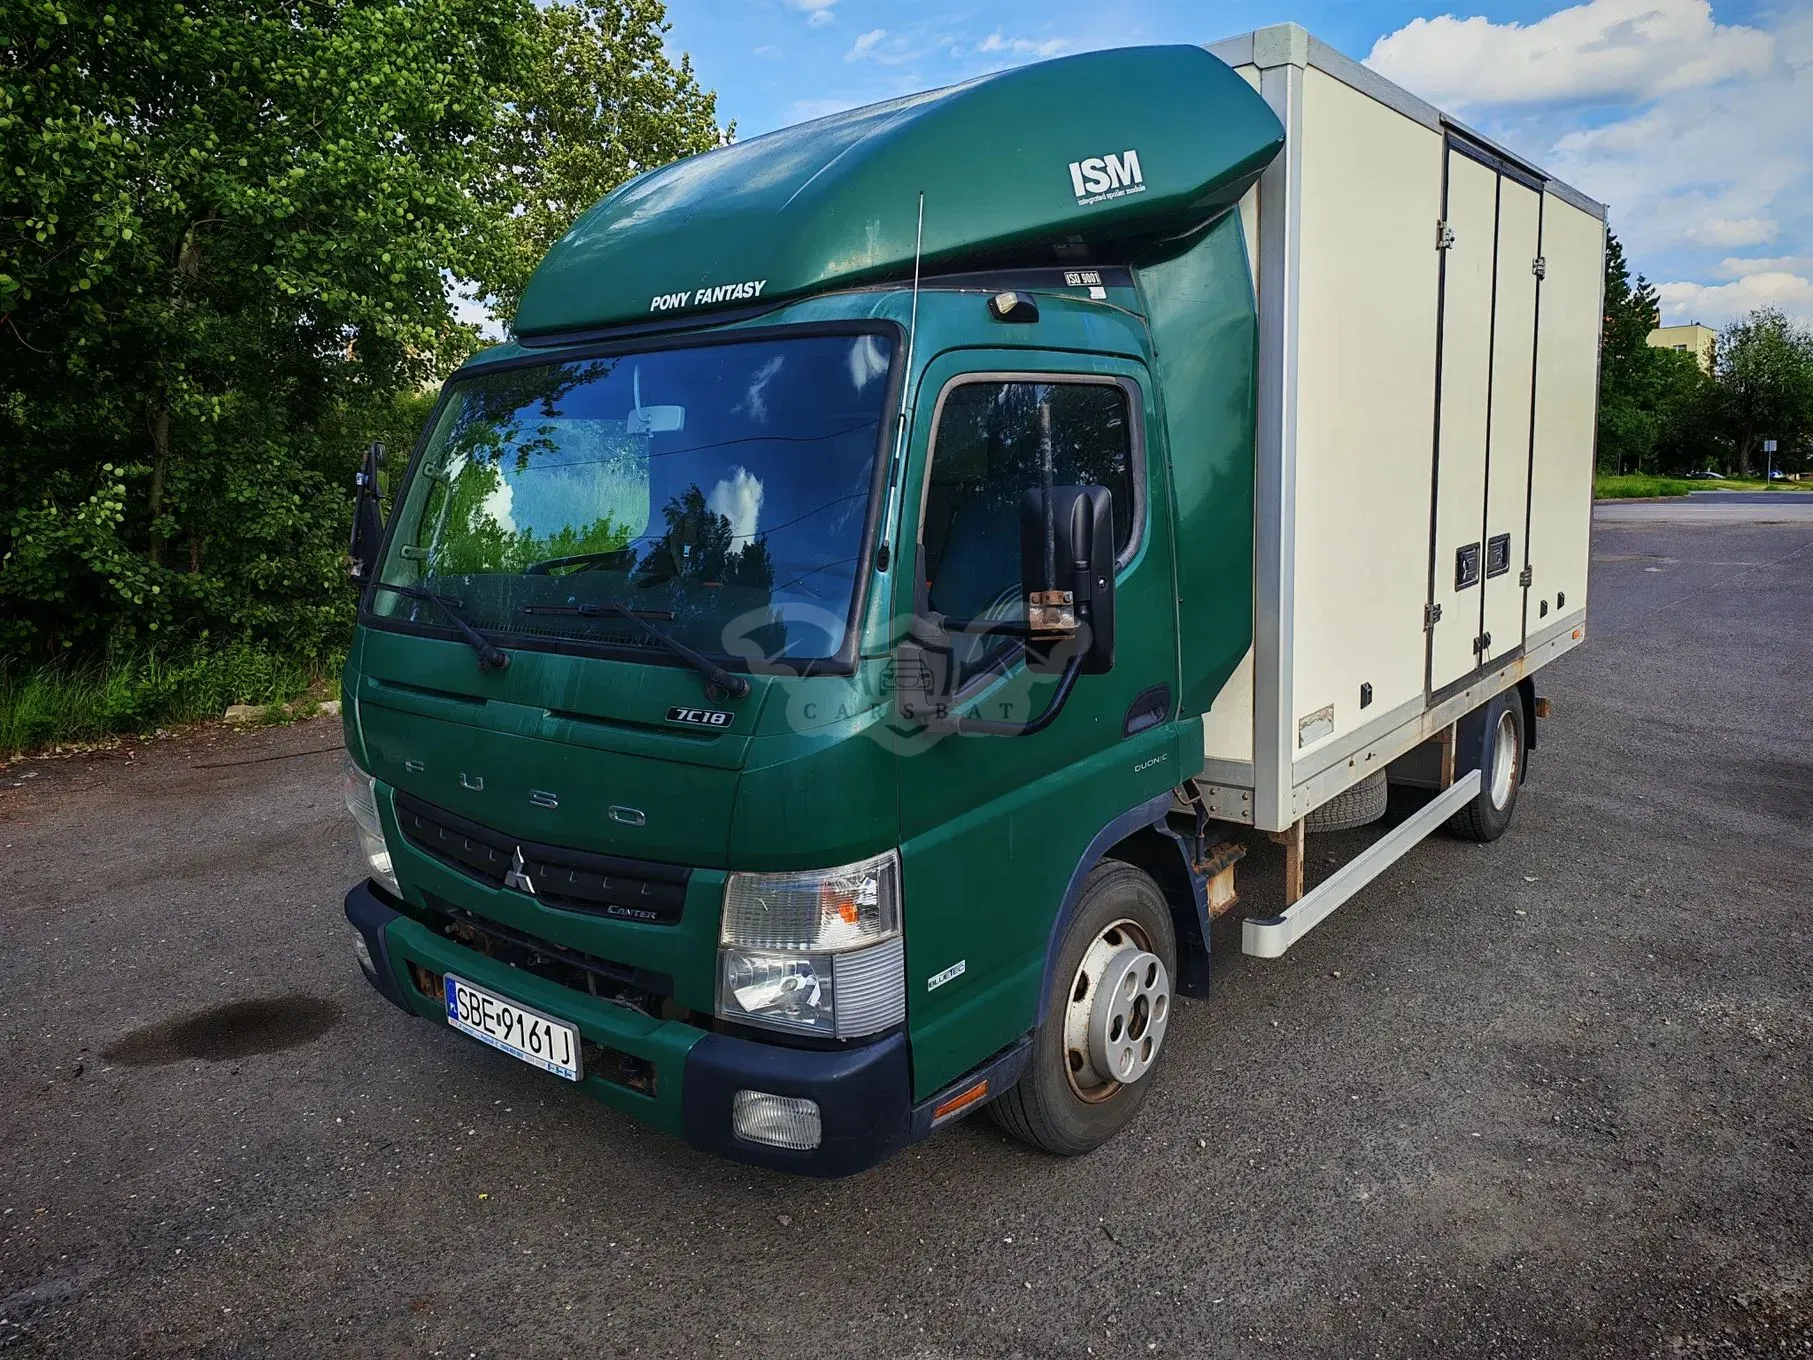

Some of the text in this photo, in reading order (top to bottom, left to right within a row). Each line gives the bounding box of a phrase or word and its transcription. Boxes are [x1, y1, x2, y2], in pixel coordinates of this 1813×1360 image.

[1069, 150, 1143, 197] ISM
[1066, 272, 1100, 284] ISO 9001
[650, 280, 767, 312] PONY FANTASY
[676, 709, 726, 724] 7C18
[404, 759, 646, 827] FUSO
